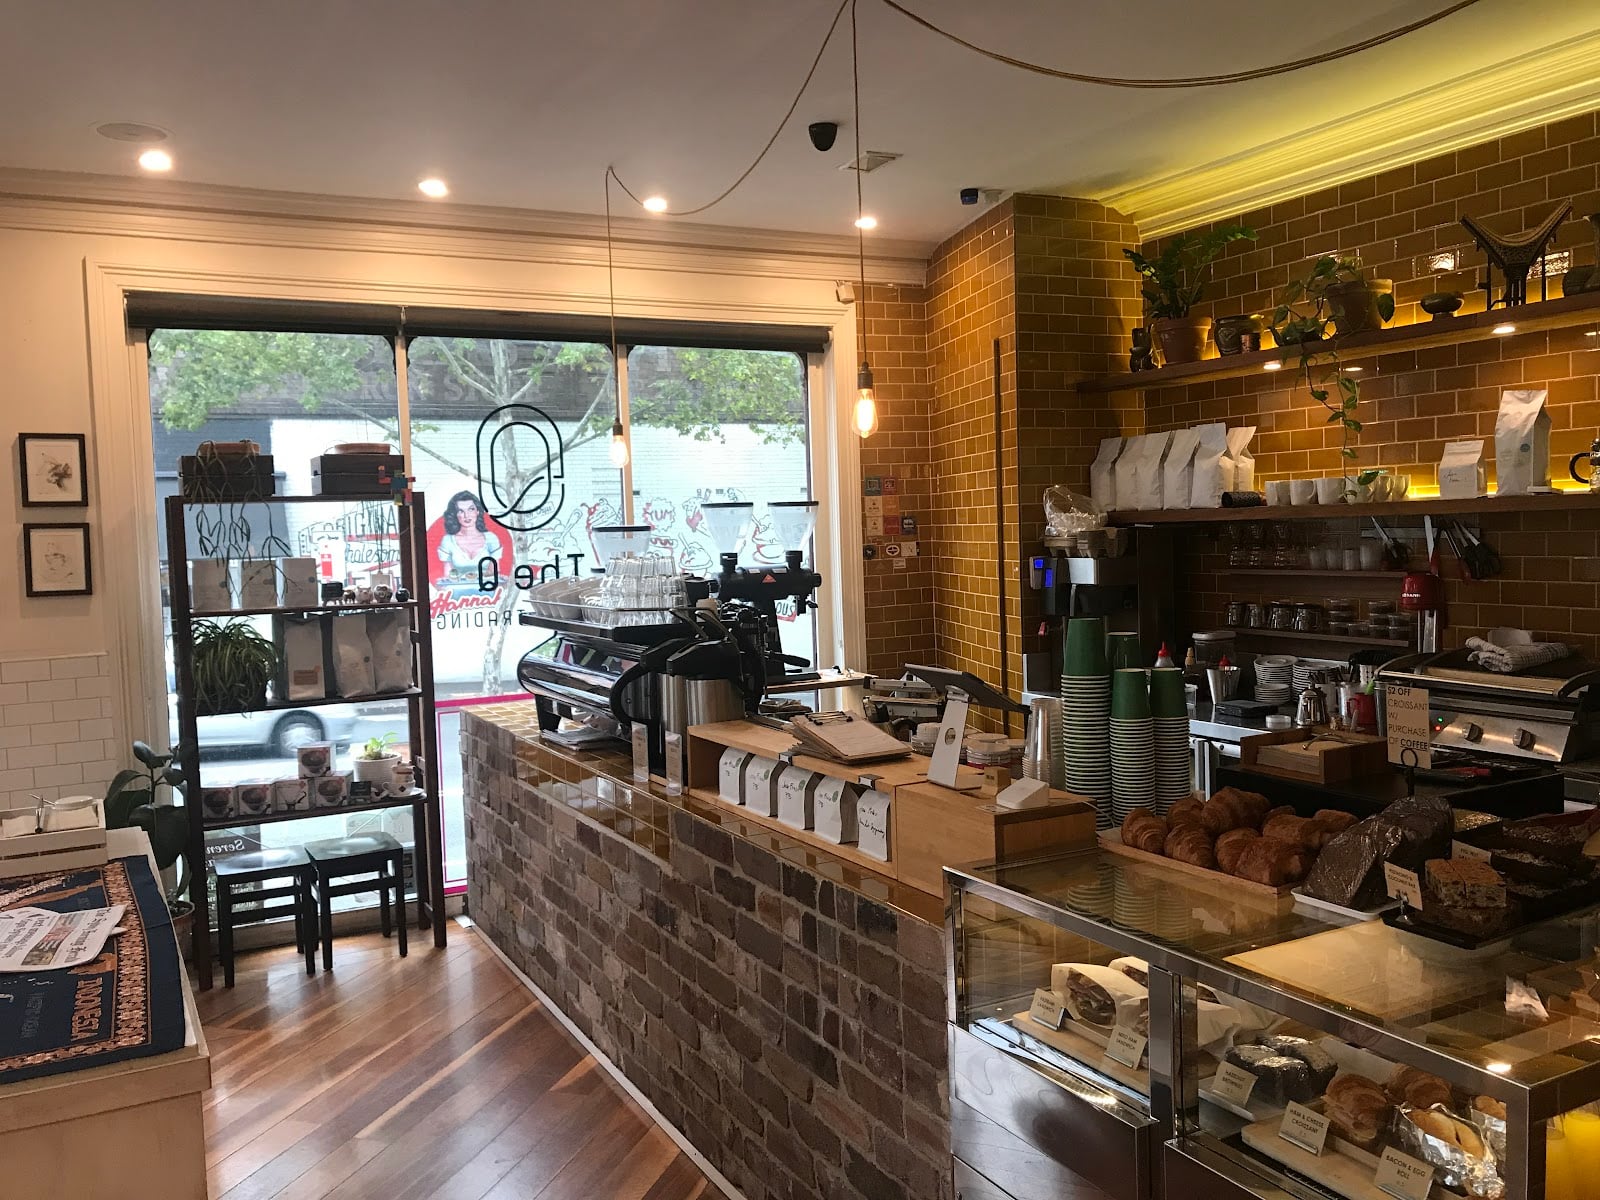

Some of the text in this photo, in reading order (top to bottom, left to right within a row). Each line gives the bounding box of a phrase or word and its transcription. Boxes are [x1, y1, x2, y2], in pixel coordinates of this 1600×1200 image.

[346, 543, 400, 564] holesom
[1397, 687, 1411, 696] OFF
[1388, 723, 1427, 738] PURCHASE
[1388, 736, 1428, 751] OF COFFEE
[70, 976, 103, 1041] INDONESIA
[1386, 1155, 1407, 1168] BACON
[1412, 1167, 1426, 1177] EGG
